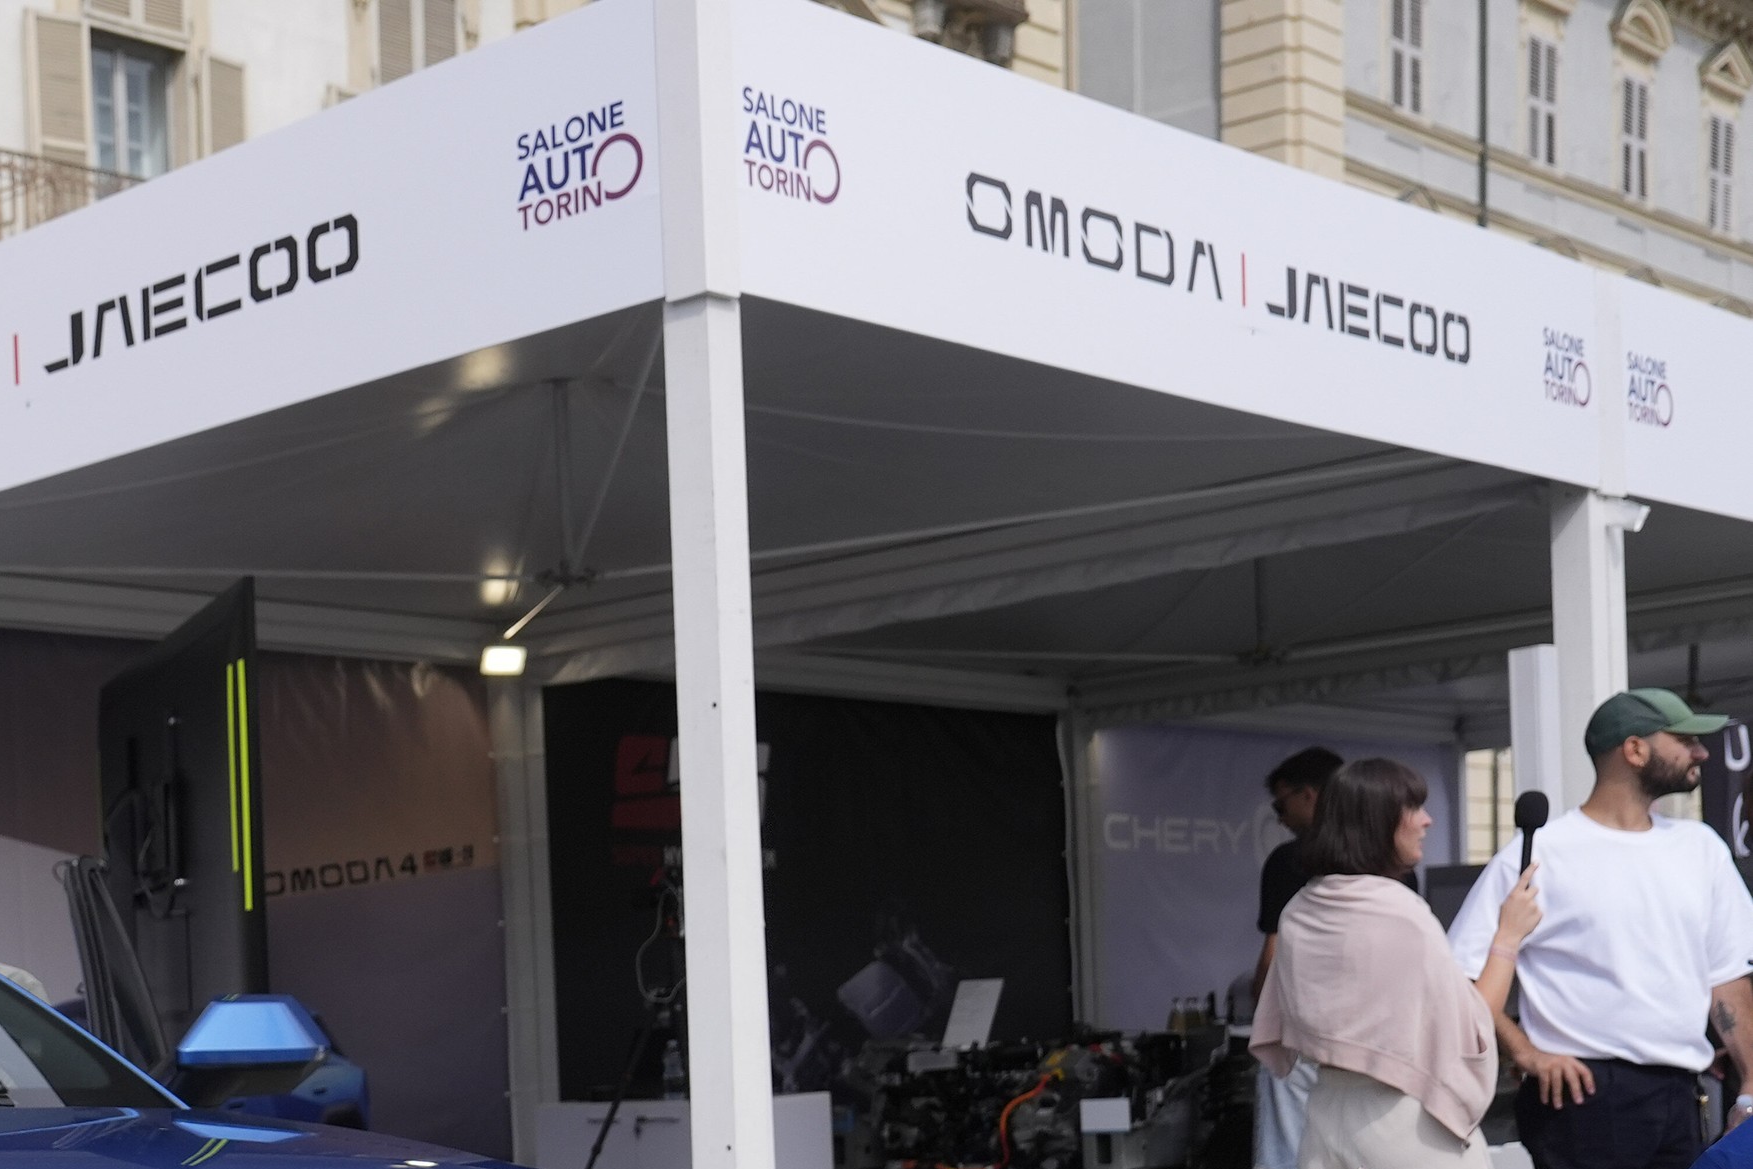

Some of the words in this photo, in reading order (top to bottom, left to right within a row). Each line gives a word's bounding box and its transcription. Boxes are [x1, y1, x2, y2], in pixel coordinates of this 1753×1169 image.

[517, 101, 624, 160] SALONE
[743, 87, 826, 135] SALONE
[519, 133, 643, 202] AUTO
[745, 120, 840, 204] AUTO
[44, 213, 360, 374] JAECOO
[966, 173, 1224, 300] OMODA
[1266, 265, 1471, 365] JAECOO
[1543, 326, 1584, 358] SALONE
[1627, 350, 1666, 381] SALONE
[1544, 350, 1591, 406] AUTO
[1628, 373, 1674, 427] AUTO
[1103, 813, 1248, 855] CHERY
